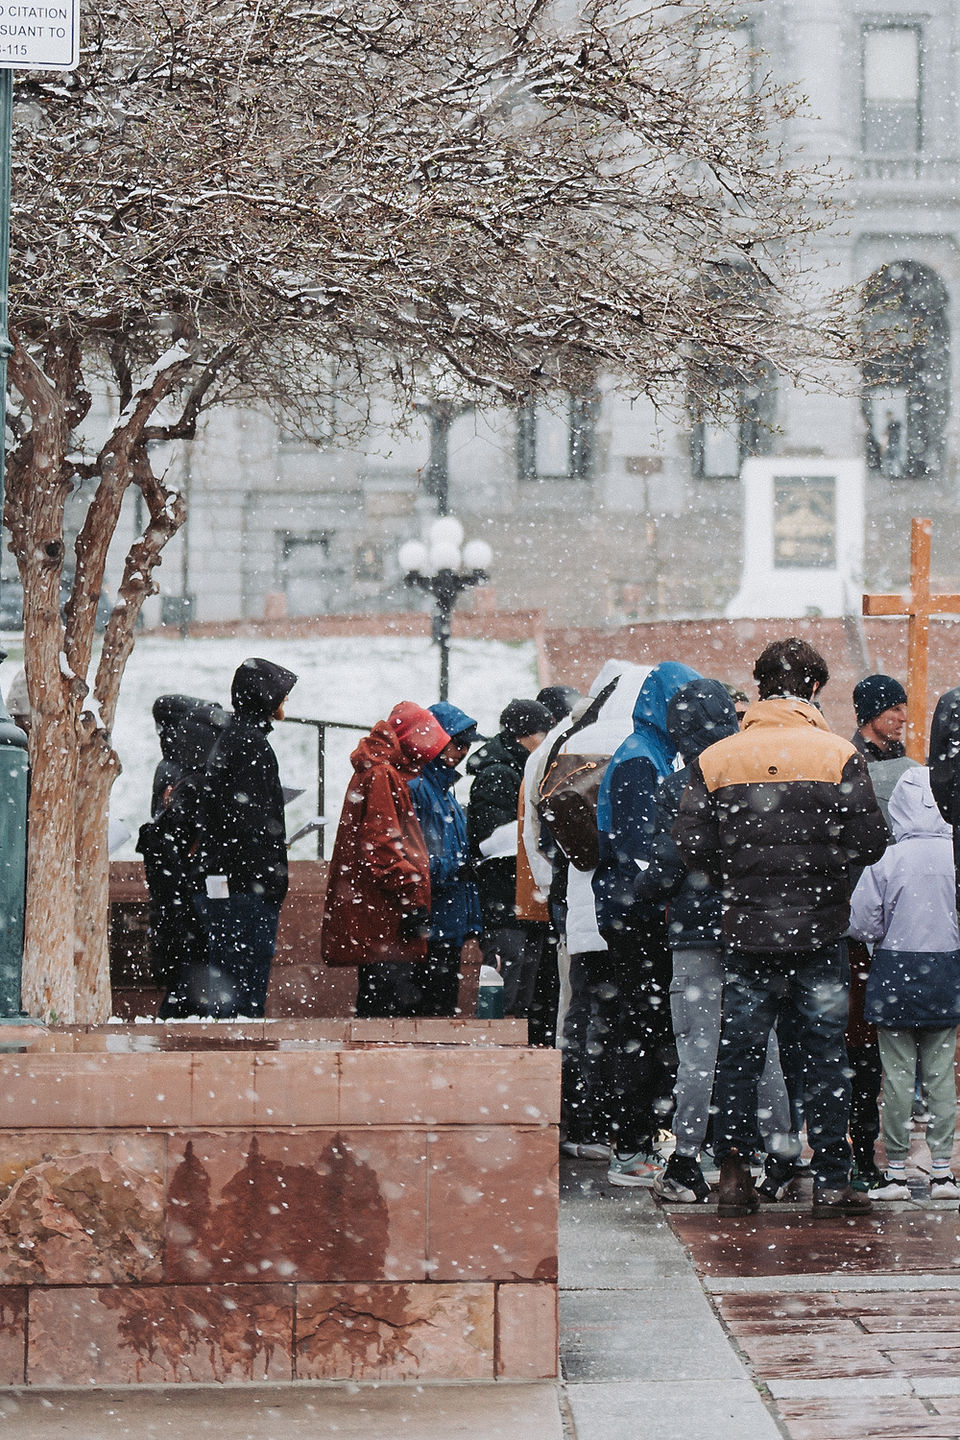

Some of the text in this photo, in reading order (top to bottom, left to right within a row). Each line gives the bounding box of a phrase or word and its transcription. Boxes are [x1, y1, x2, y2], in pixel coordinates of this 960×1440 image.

[8, 5, 67, 19] CITATION
[49, 27, 66, 38] TO
[0, 44, 27, 56] -115
